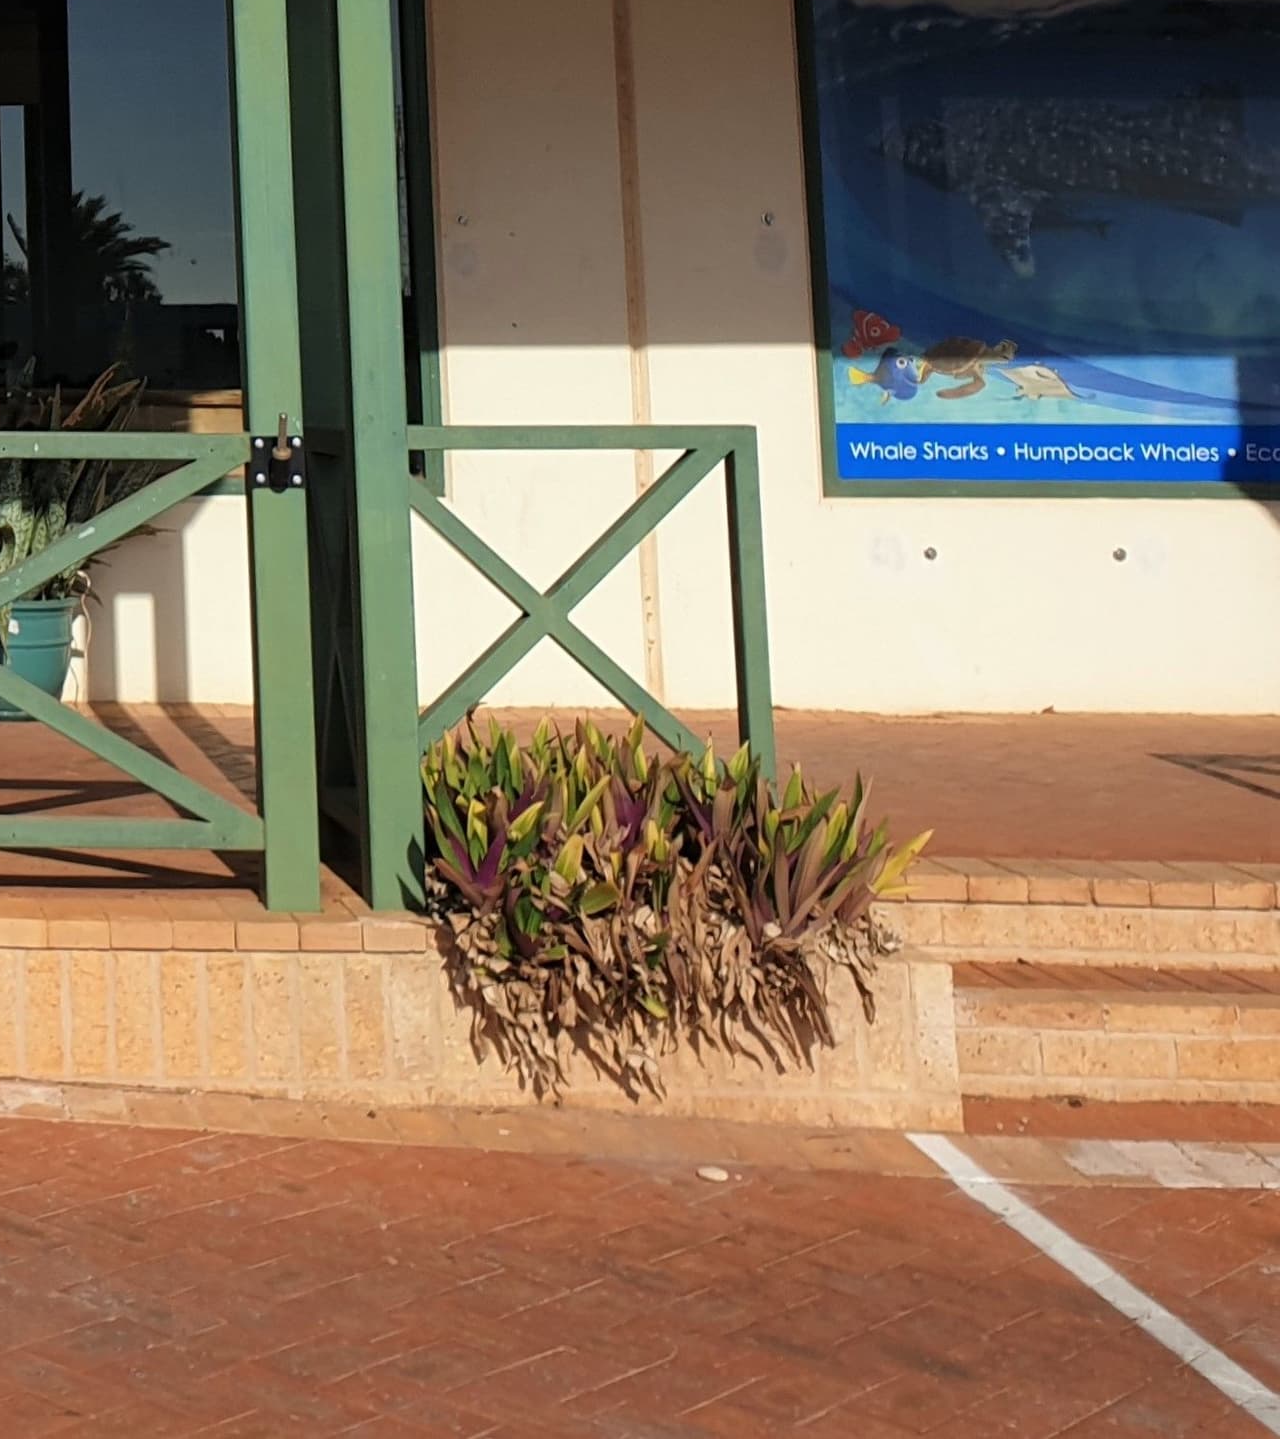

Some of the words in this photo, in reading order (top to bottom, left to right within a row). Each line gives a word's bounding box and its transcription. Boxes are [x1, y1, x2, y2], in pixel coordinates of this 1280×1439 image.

[849, 441, 917, 461] Whale
[923, 441, 989, 461] Sharks
[1013, 442, 1135, 465] Humpback
[1140, 442, 1220, 462] Whales
